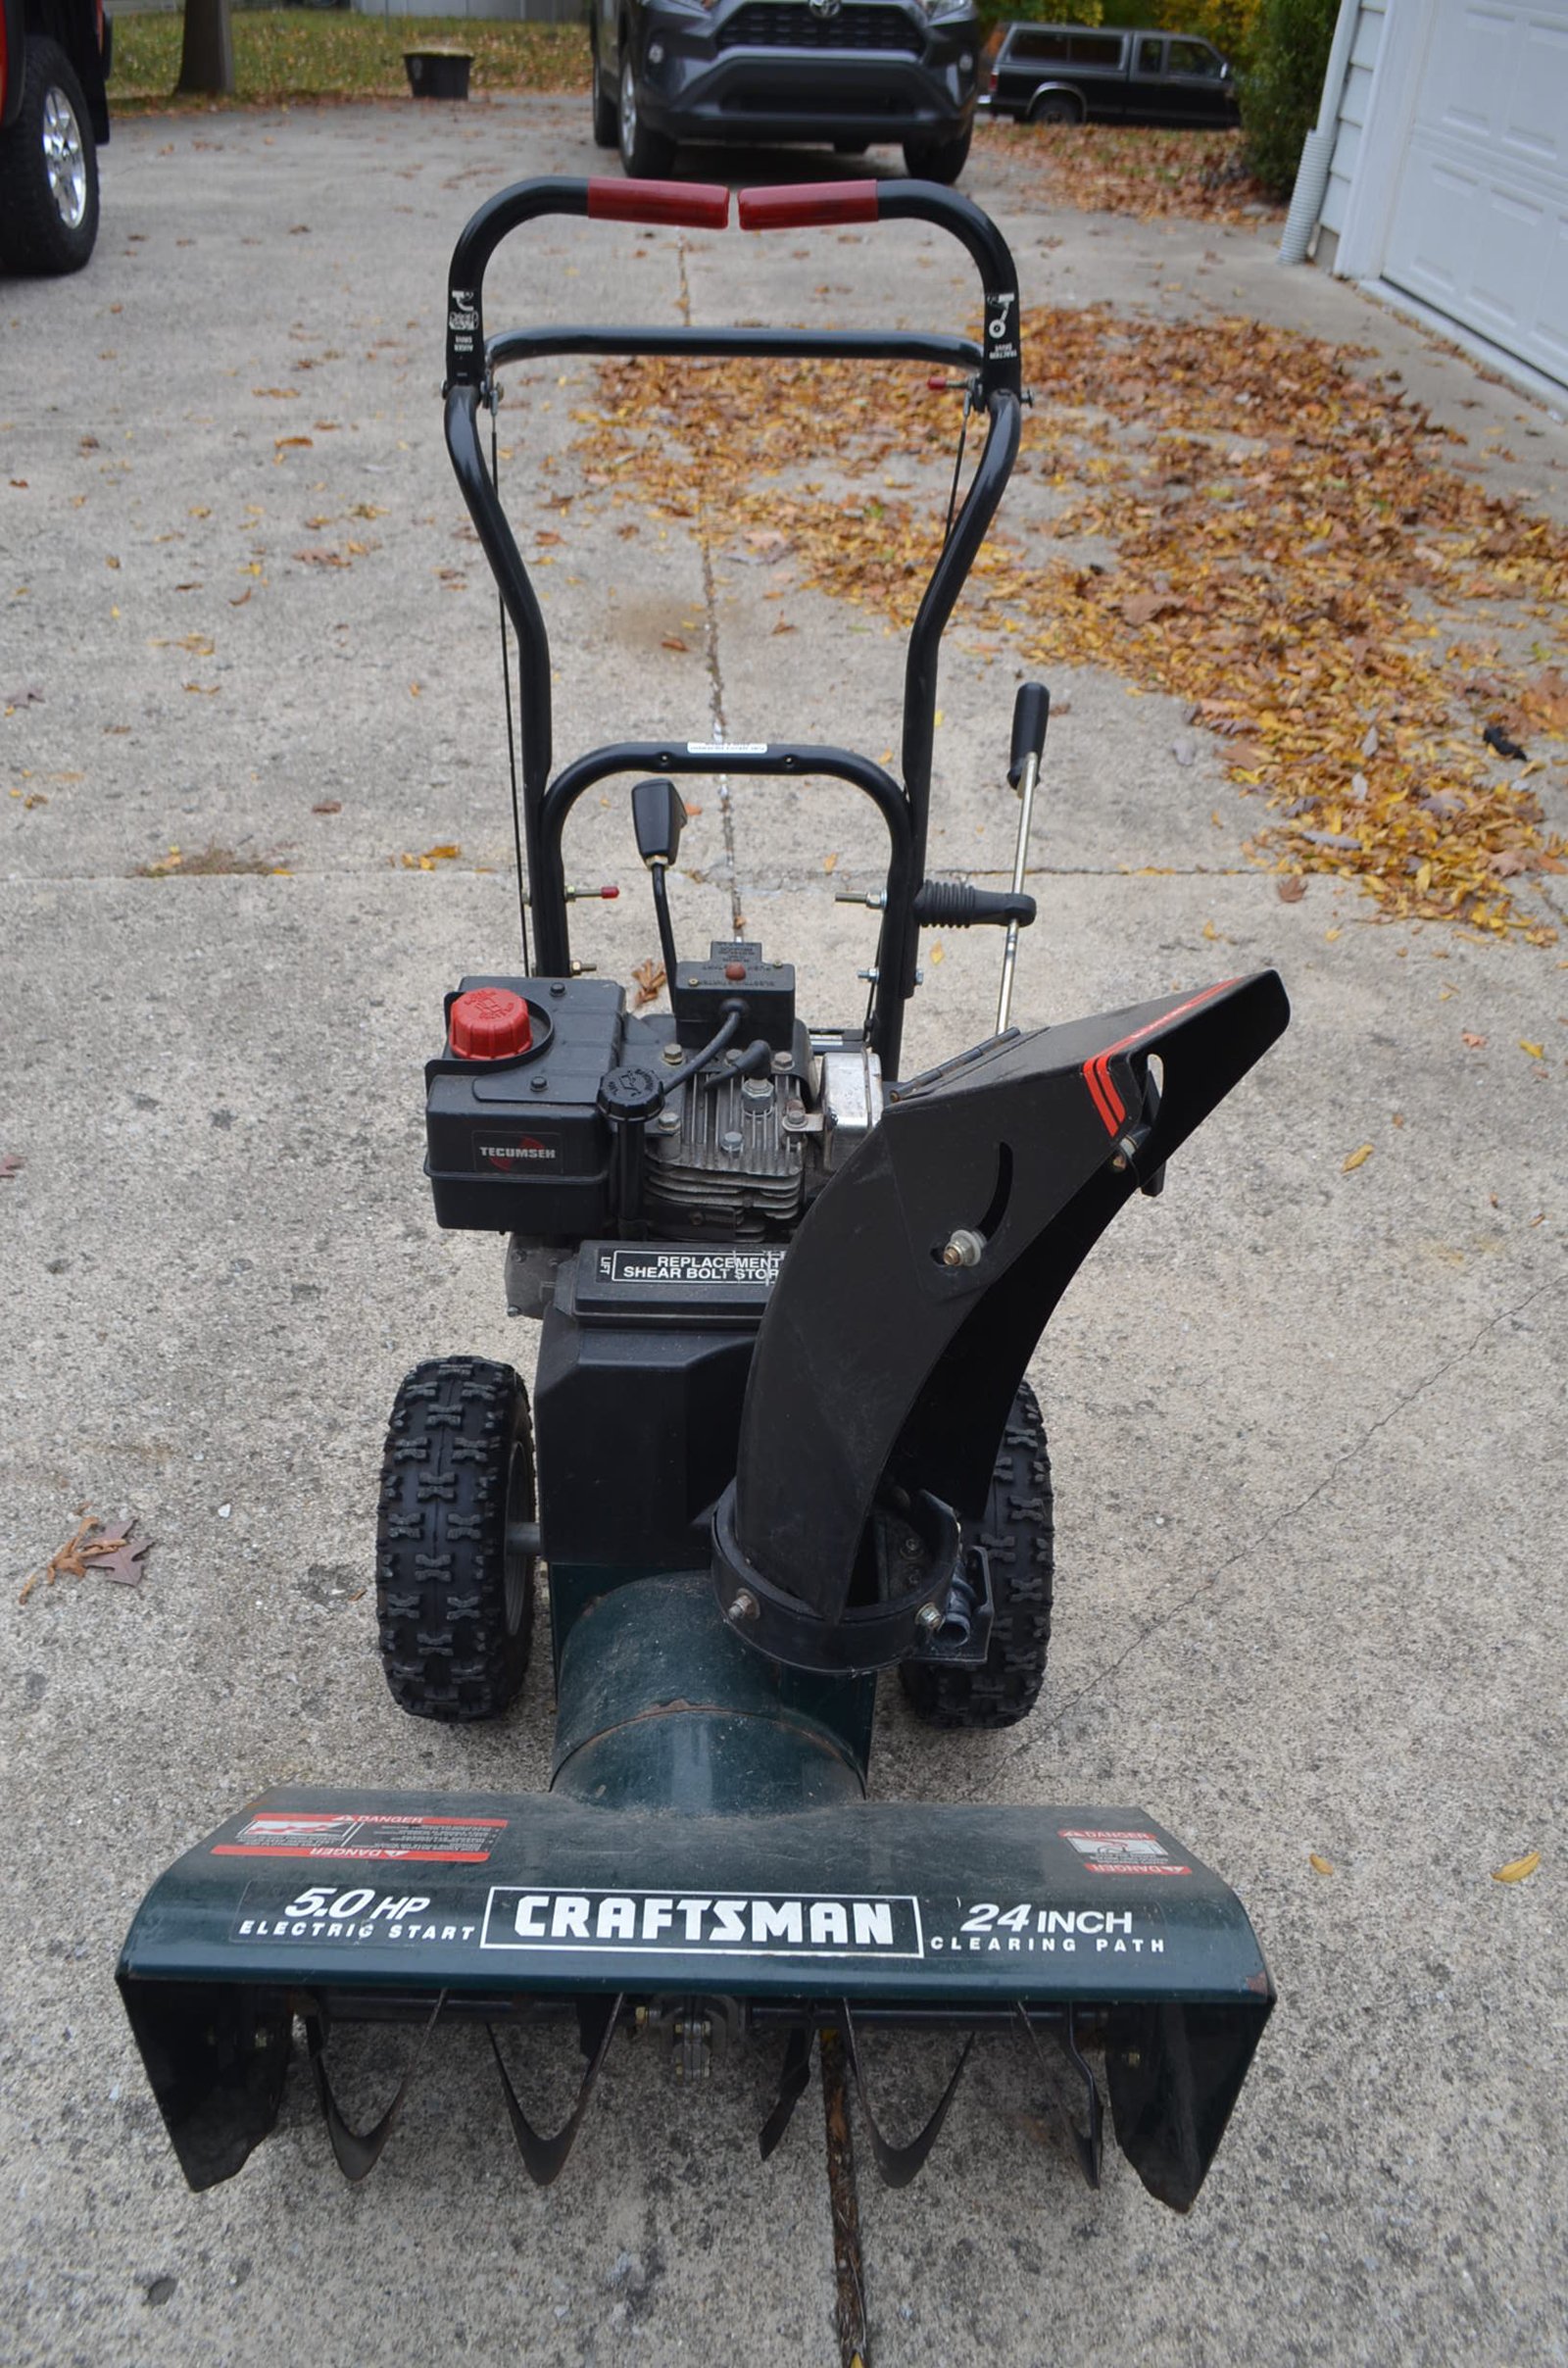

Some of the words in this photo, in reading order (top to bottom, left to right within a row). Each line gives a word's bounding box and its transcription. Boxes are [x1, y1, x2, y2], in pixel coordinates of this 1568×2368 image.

[479, 1146, 557, 1159] TECUMSEH
[657, 1256, 780, 1269] REPLACEMENT
[623, 1265, 682, 1279] SHEAR
[686, 1267, 731, 1280] BOLT
[357, 1814, 424, 1824] DANGER
[1084, 1830, 1150, 1840] DANGER
[309, 1847, 383, 1857] DANGER
[1092, 1864, 1162, 1874] DANGER
[284, 1887, 375, 1919] 5.0
[369, 1896, 431, 1920] HP
[514, 1896, 894, 1946] CRAFTSMAN
[959, 1902, 1032, 1933] 24
[1037, 1910, 1133, 1934] INCH
[238, 1919, 374, 1940] ELECTRIC
[388, 1924, 475, 1942] START
[930, 1937, 1076, 1952] CLEARING
[1096, 1939, 1165, 1953] PATH
